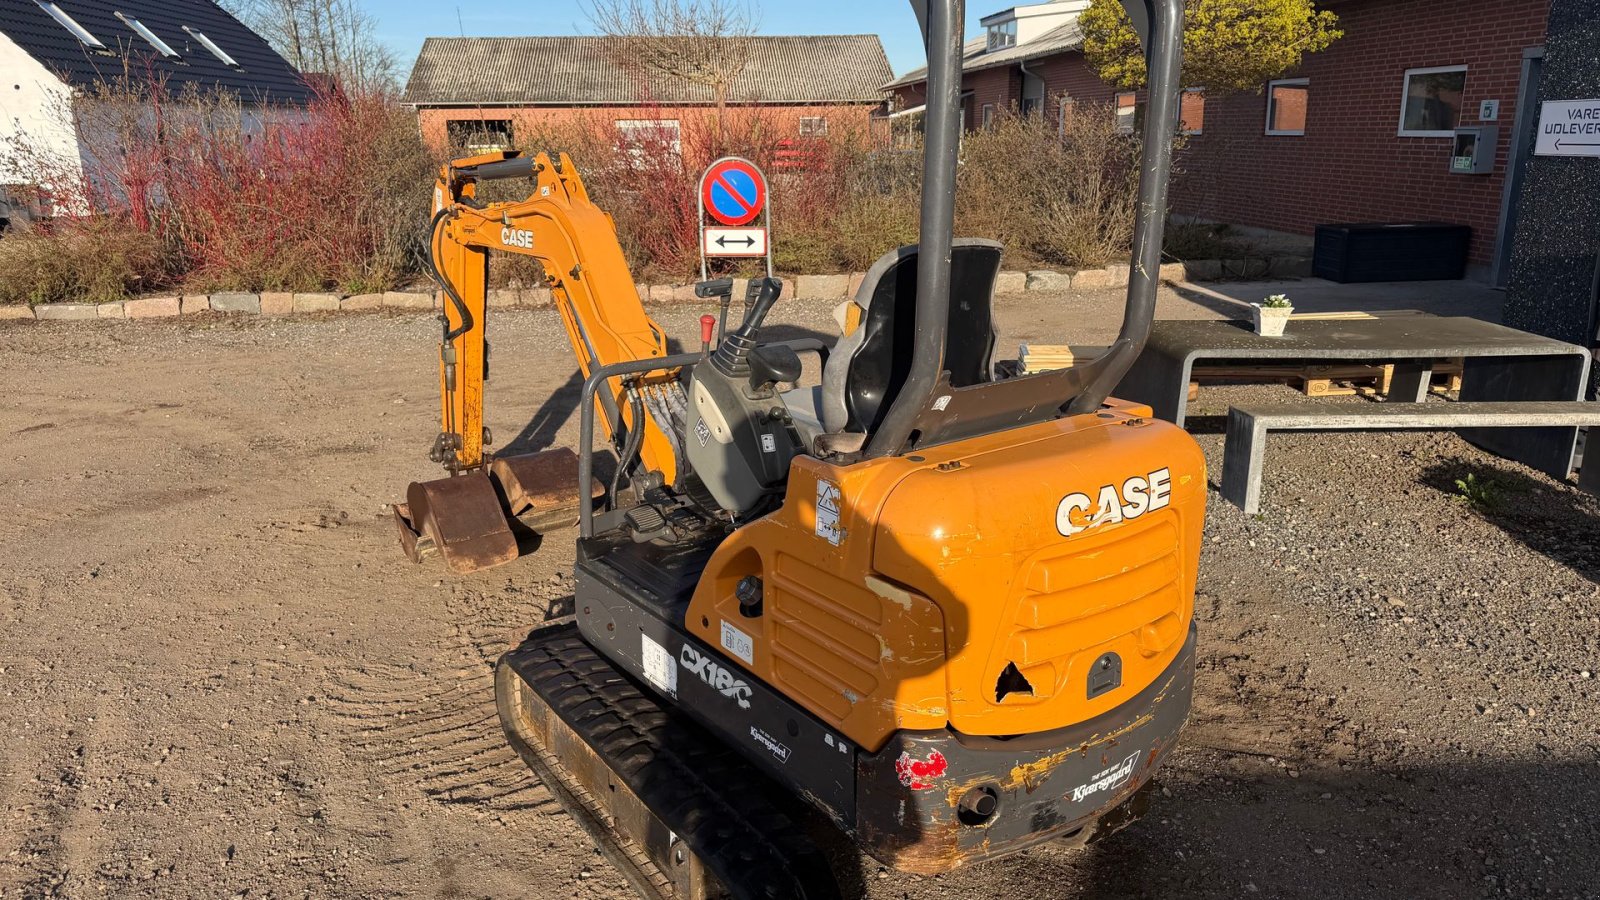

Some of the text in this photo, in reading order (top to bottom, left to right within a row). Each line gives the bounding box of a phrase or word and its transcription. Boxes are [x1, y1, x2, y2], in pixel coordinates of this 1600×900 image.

[1567, 108, 1600, 120] VARE
[501, 227, 534, 249] CASE
[1055, 466, 1172, 538] CASE
[1071, 758, 1133, 802] Kjærsgaard
